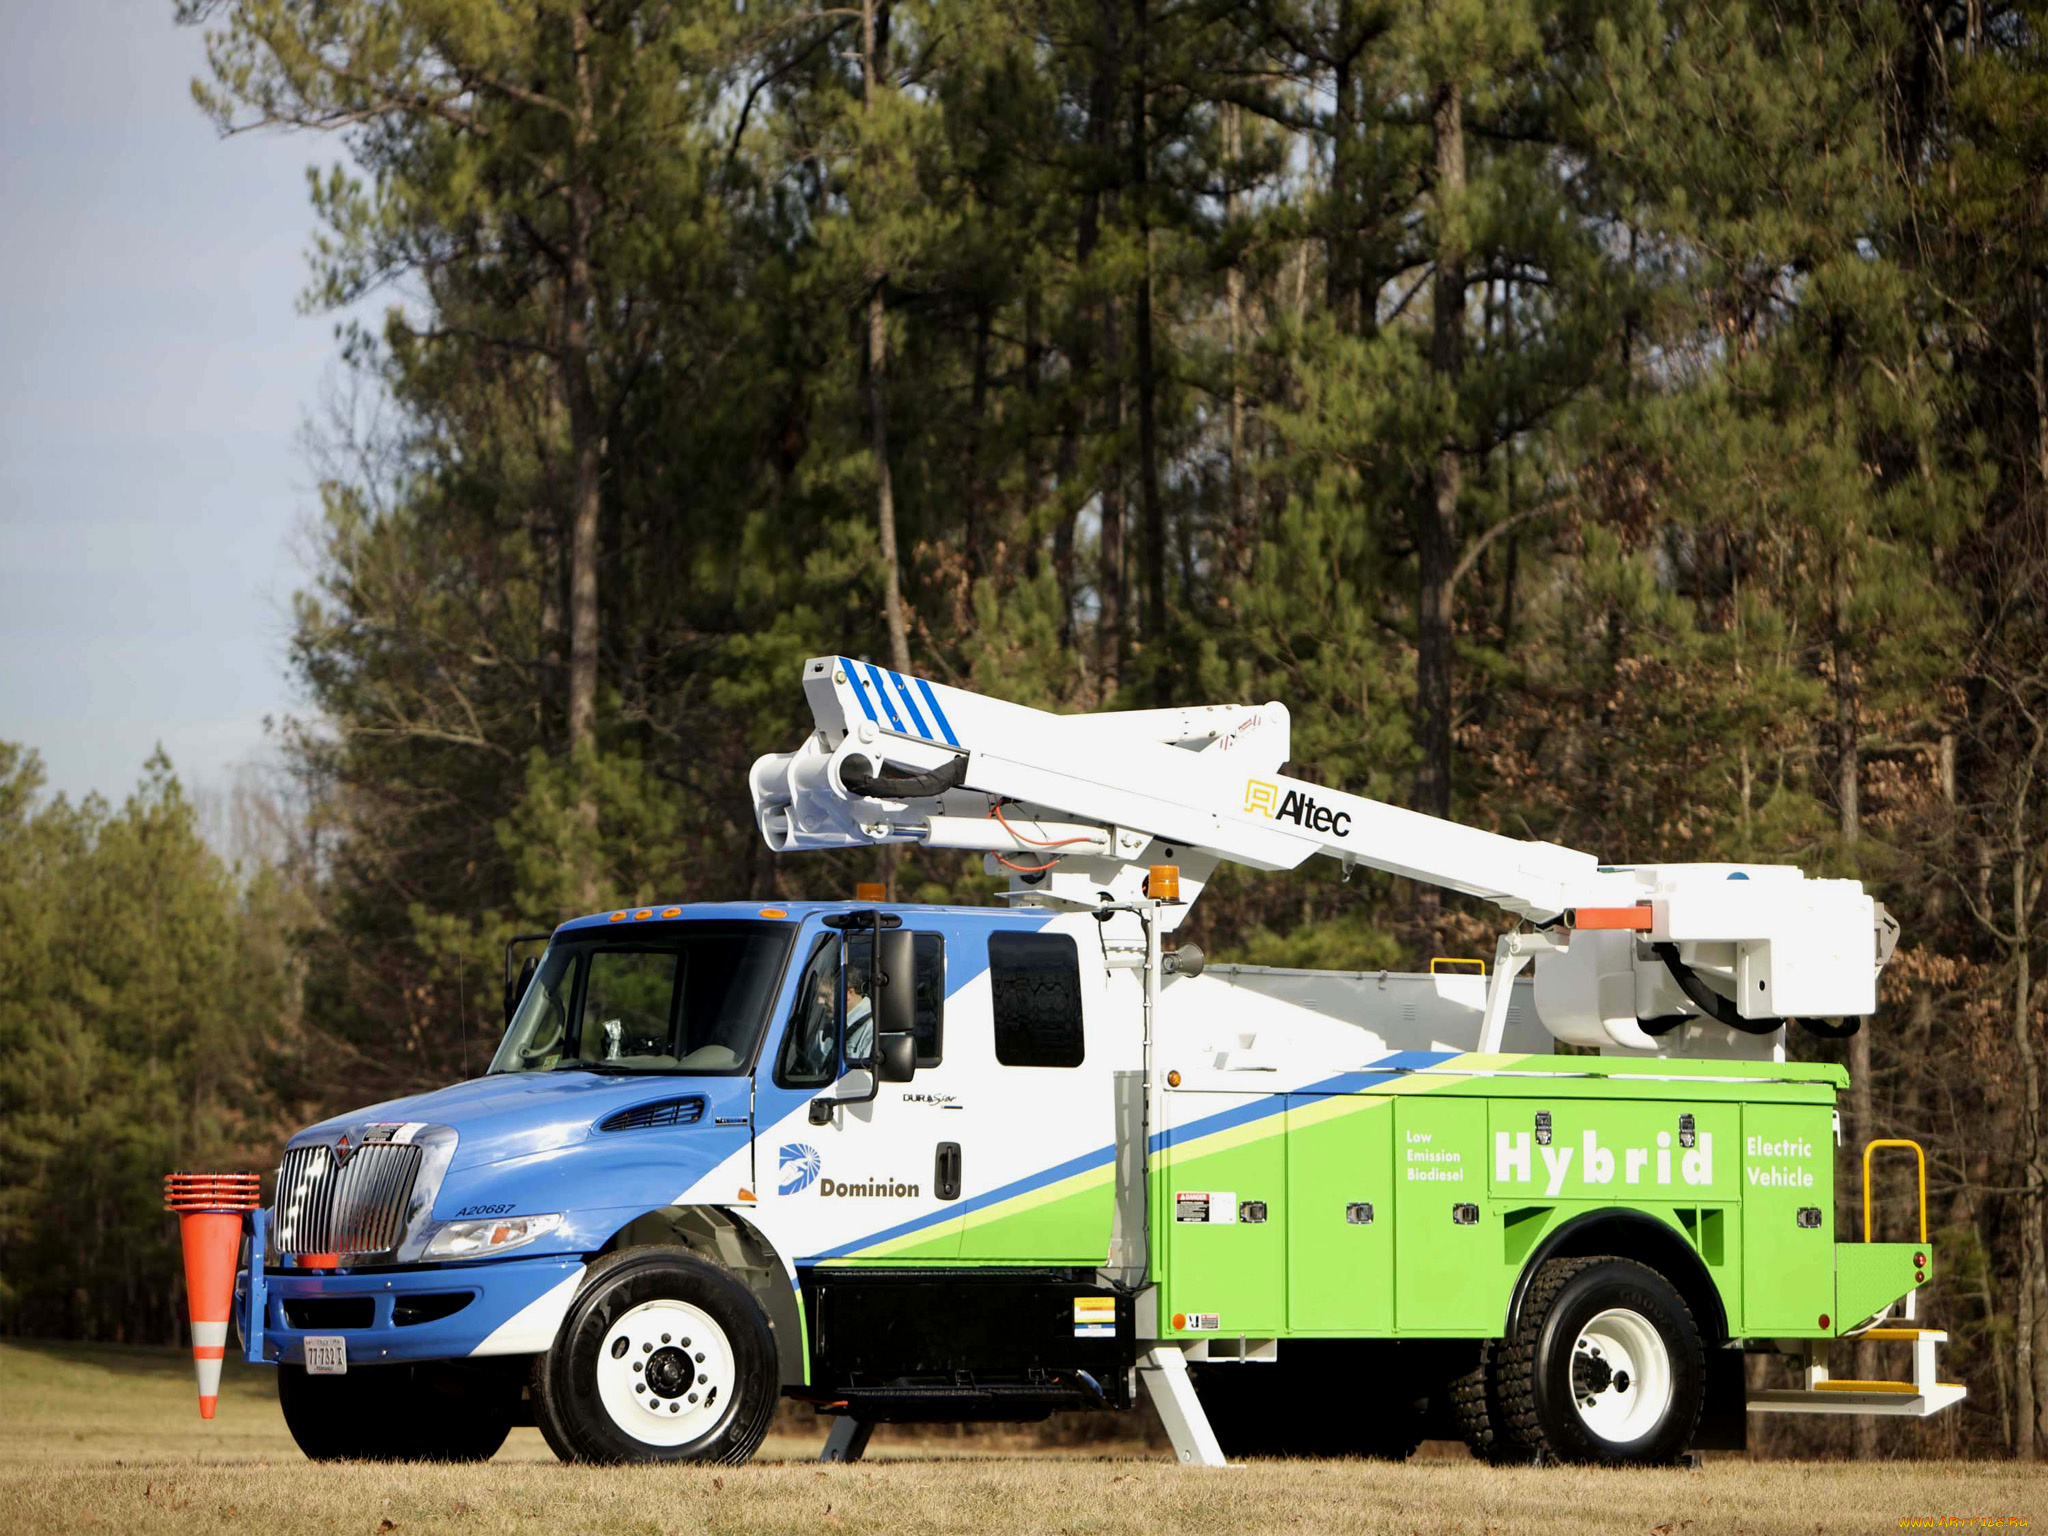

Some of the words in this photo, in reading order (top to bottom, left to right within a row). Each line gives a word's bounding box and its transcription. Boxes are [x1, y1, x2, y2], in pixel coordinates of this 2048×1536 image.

[1275, 789, 1352, 837] Altec
[1406, 1130, 1432, 1143] Low
[1747, 1136, 1812, 1157] Electric
[1407, 1149, 1461, 1162] Emission
[1495, 1130, 1713, 1196] Hybrid
[1407, 1167, 1464, 1181] Biodiesel
[1747, 1166, 1814, 1187] Vehicle
[820, 1177, 920, 1198] Dominion
[455, 1204, 516, 1217] A20687
